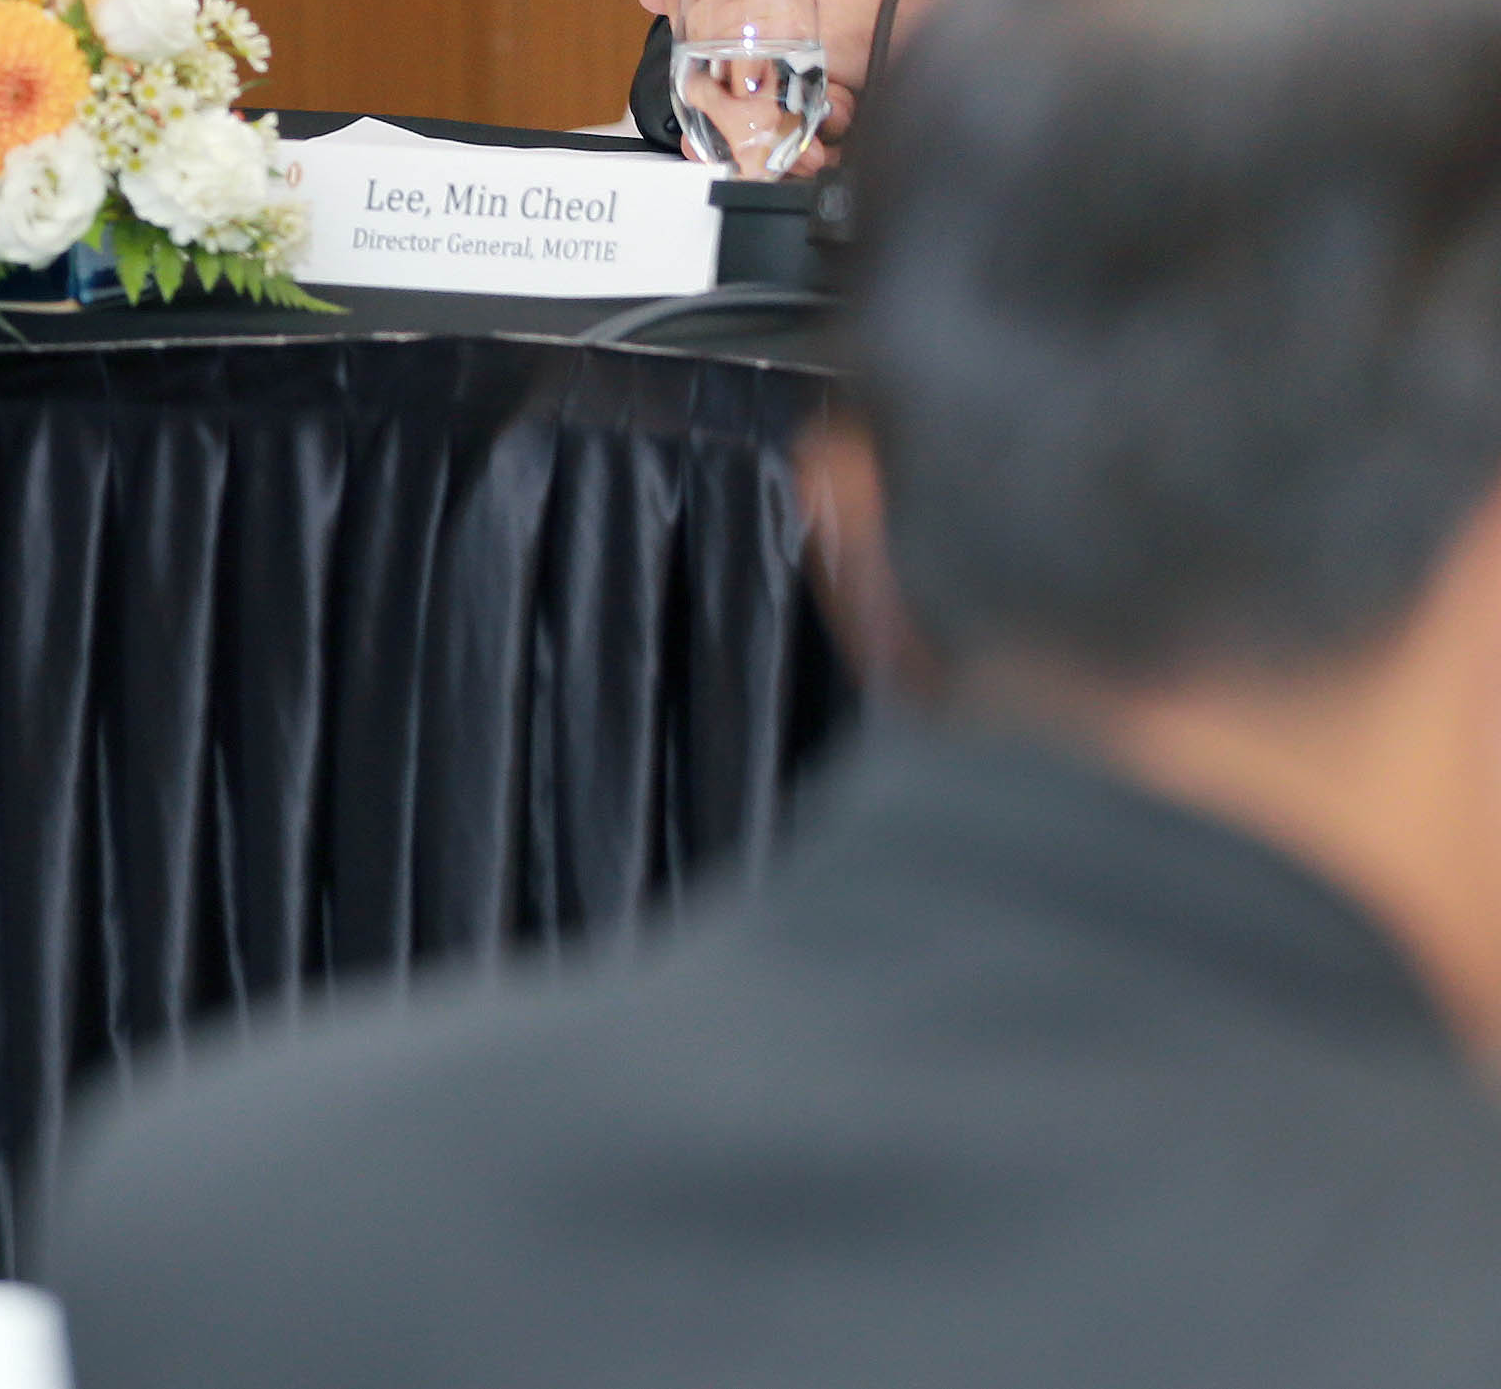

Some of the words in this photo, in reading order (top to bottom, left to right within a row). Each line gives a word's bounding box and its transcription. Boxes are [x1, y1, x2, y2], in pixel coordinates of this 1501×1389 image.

[364, 178, 431, 219] Lee,
[443, 182, 508, 218] Min
[520, 186, 618, 223] Cheol
[352, 227, 442, 253] Director
[447, 232, 535, 260] General,
[542, 237, 618, 262] MOTIE
